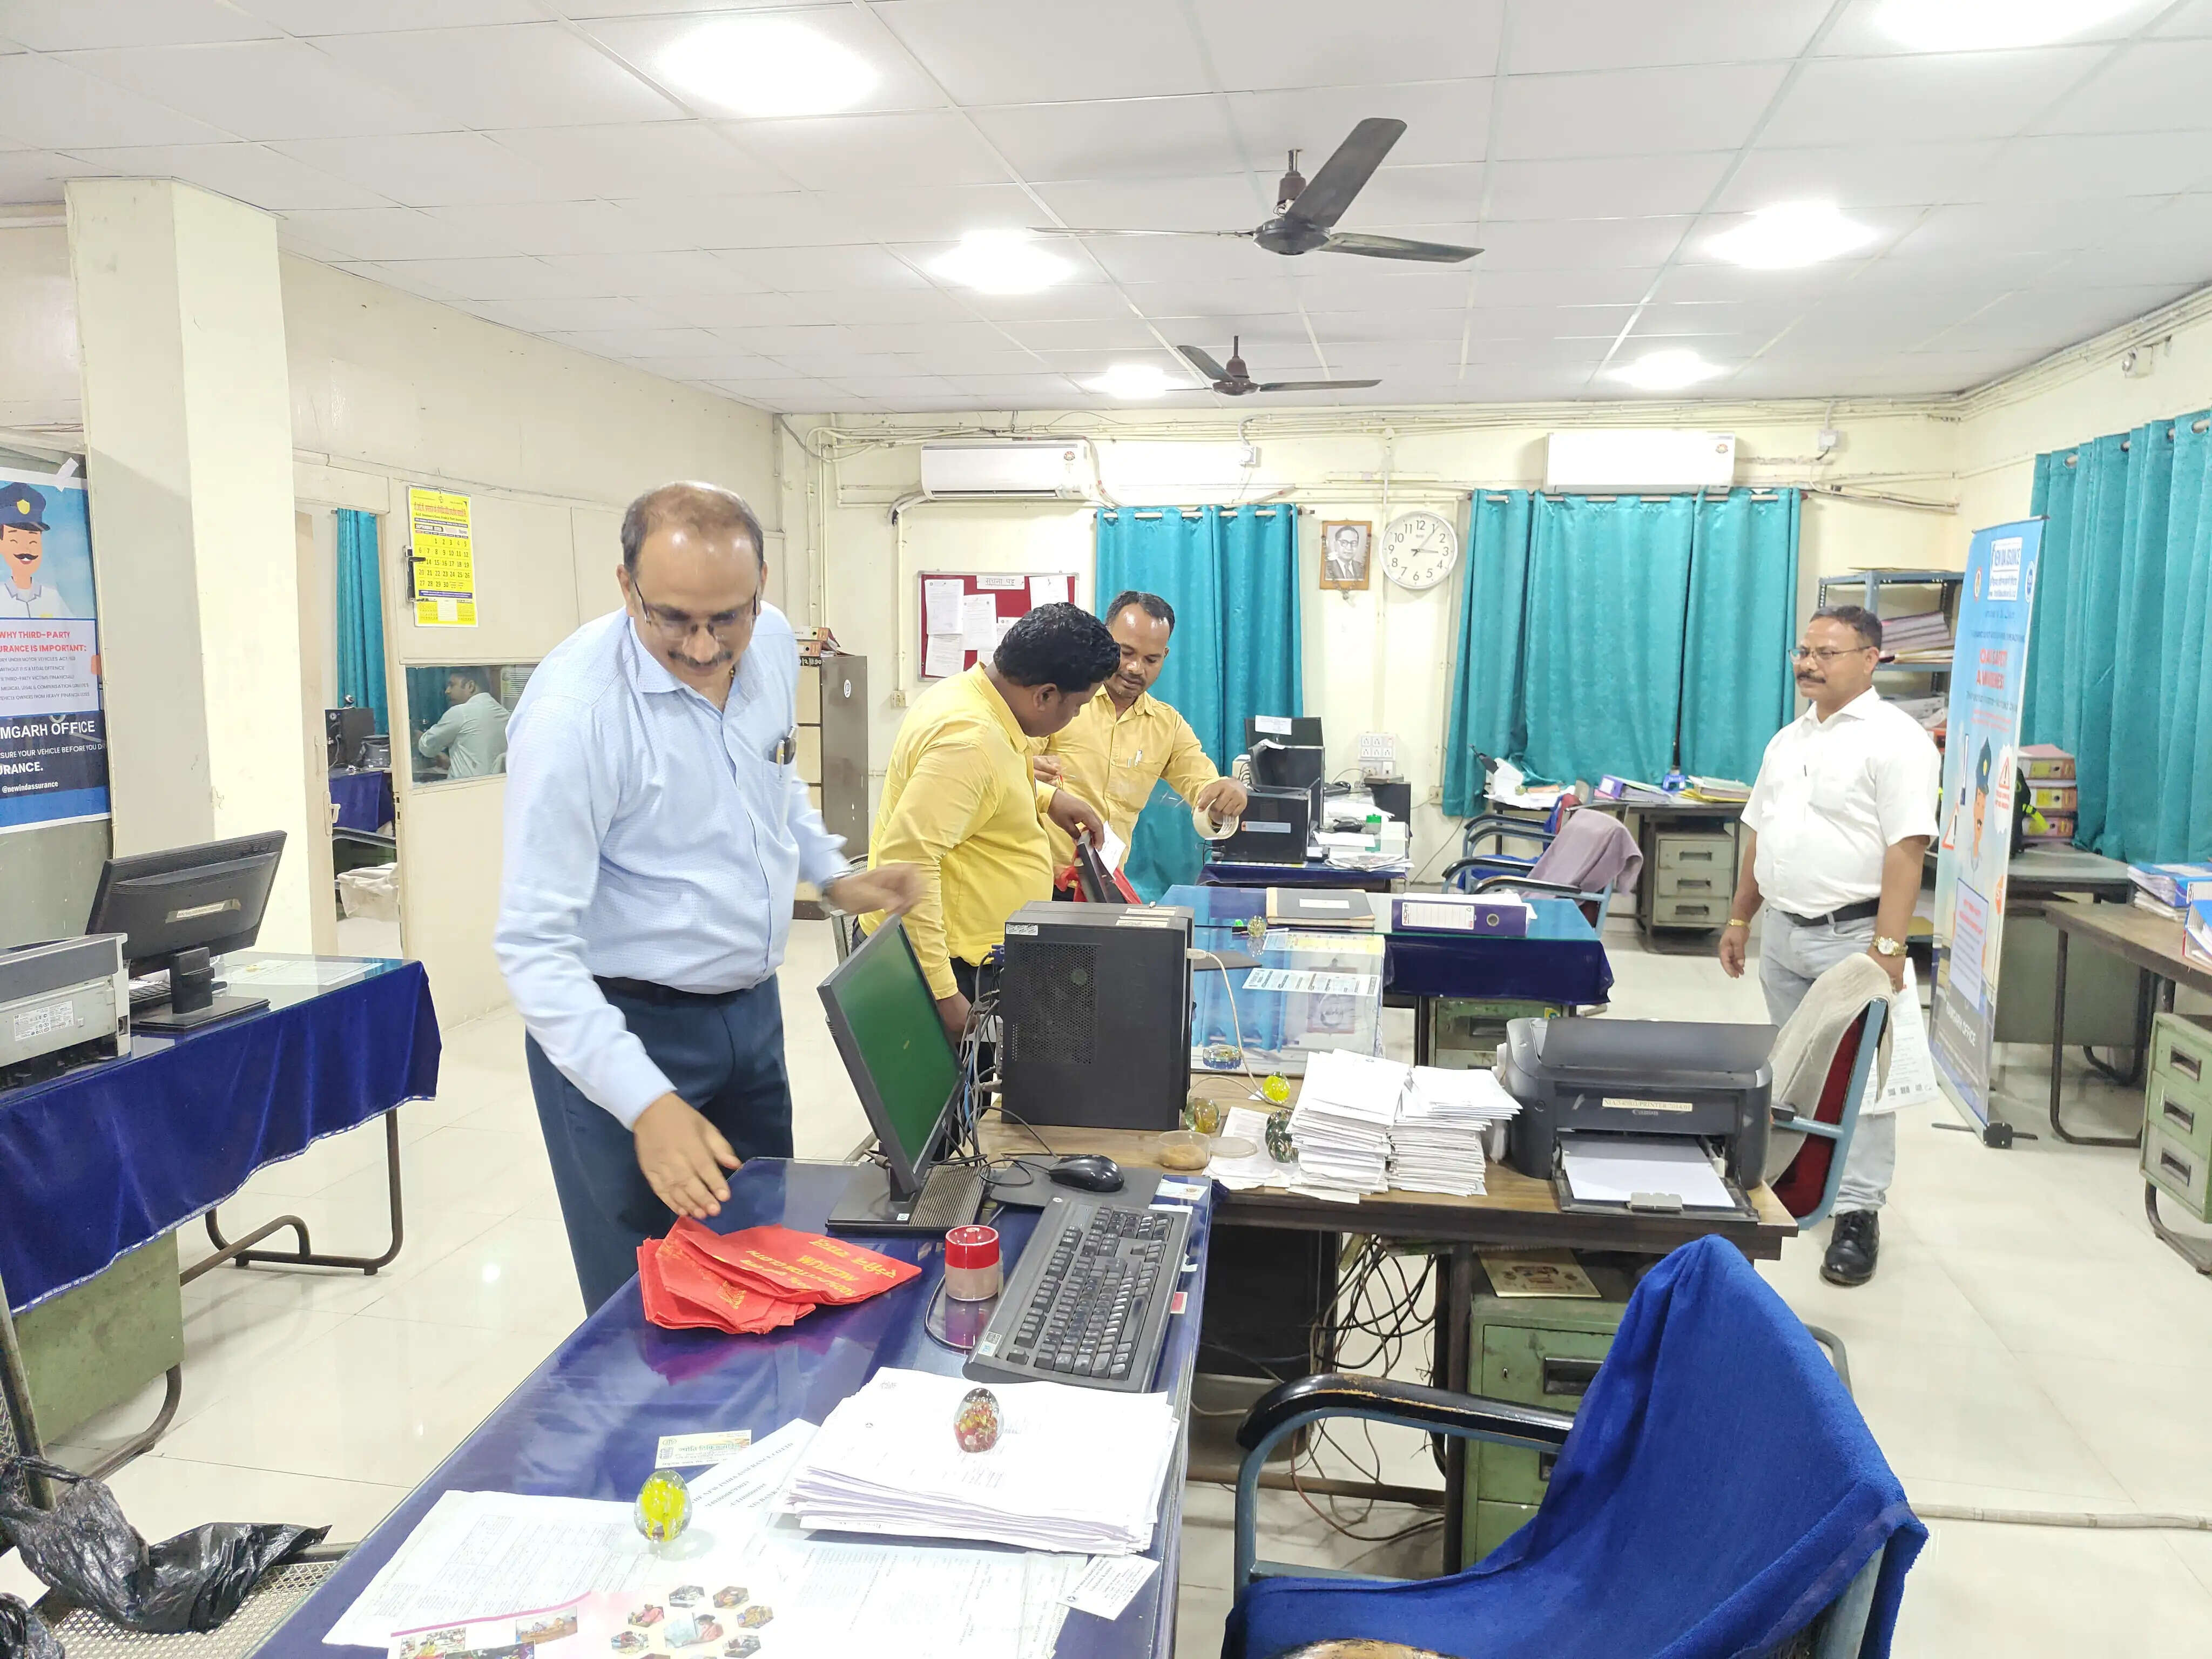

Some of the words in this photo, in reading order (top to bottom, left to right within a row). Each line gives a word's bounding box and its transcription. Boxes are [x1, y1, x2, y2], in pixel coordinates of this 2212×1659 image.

[1405, 524, 1412, 534] 11
[1416, 520, 1425, 530] 12
[1432, 524, 1435, 534] 1
[1394, 532, 1404, 543] 10
[1439, 533, 1446, 543] 2
[1388, 544, 1394, 554] 9
[1442, 547, 1449, 556] 3
[1392, 557, 1398, 567] 8
[1437, 559, 1443, 569] 4
[1401, 567, 1407, 576] 7
[1413, 571, 1419, 581] 6
[1426, 568, 1433, 578] 5
[1, 725, 48, 739] MGARH
[51, 720, 96, 735] OFFICE
[1, 750, 17, 759] SURE
[18, 749, 36, 757] YOUR
[37, 747, 60, 756] VEHICLE
[62, 745, 85, 753] BEFORE
[2, 780, 59, 793] @newindassurance
[797, 1255, 860, 1281] MEDIUM
[719, 1475, 738, 1487] INDIA
